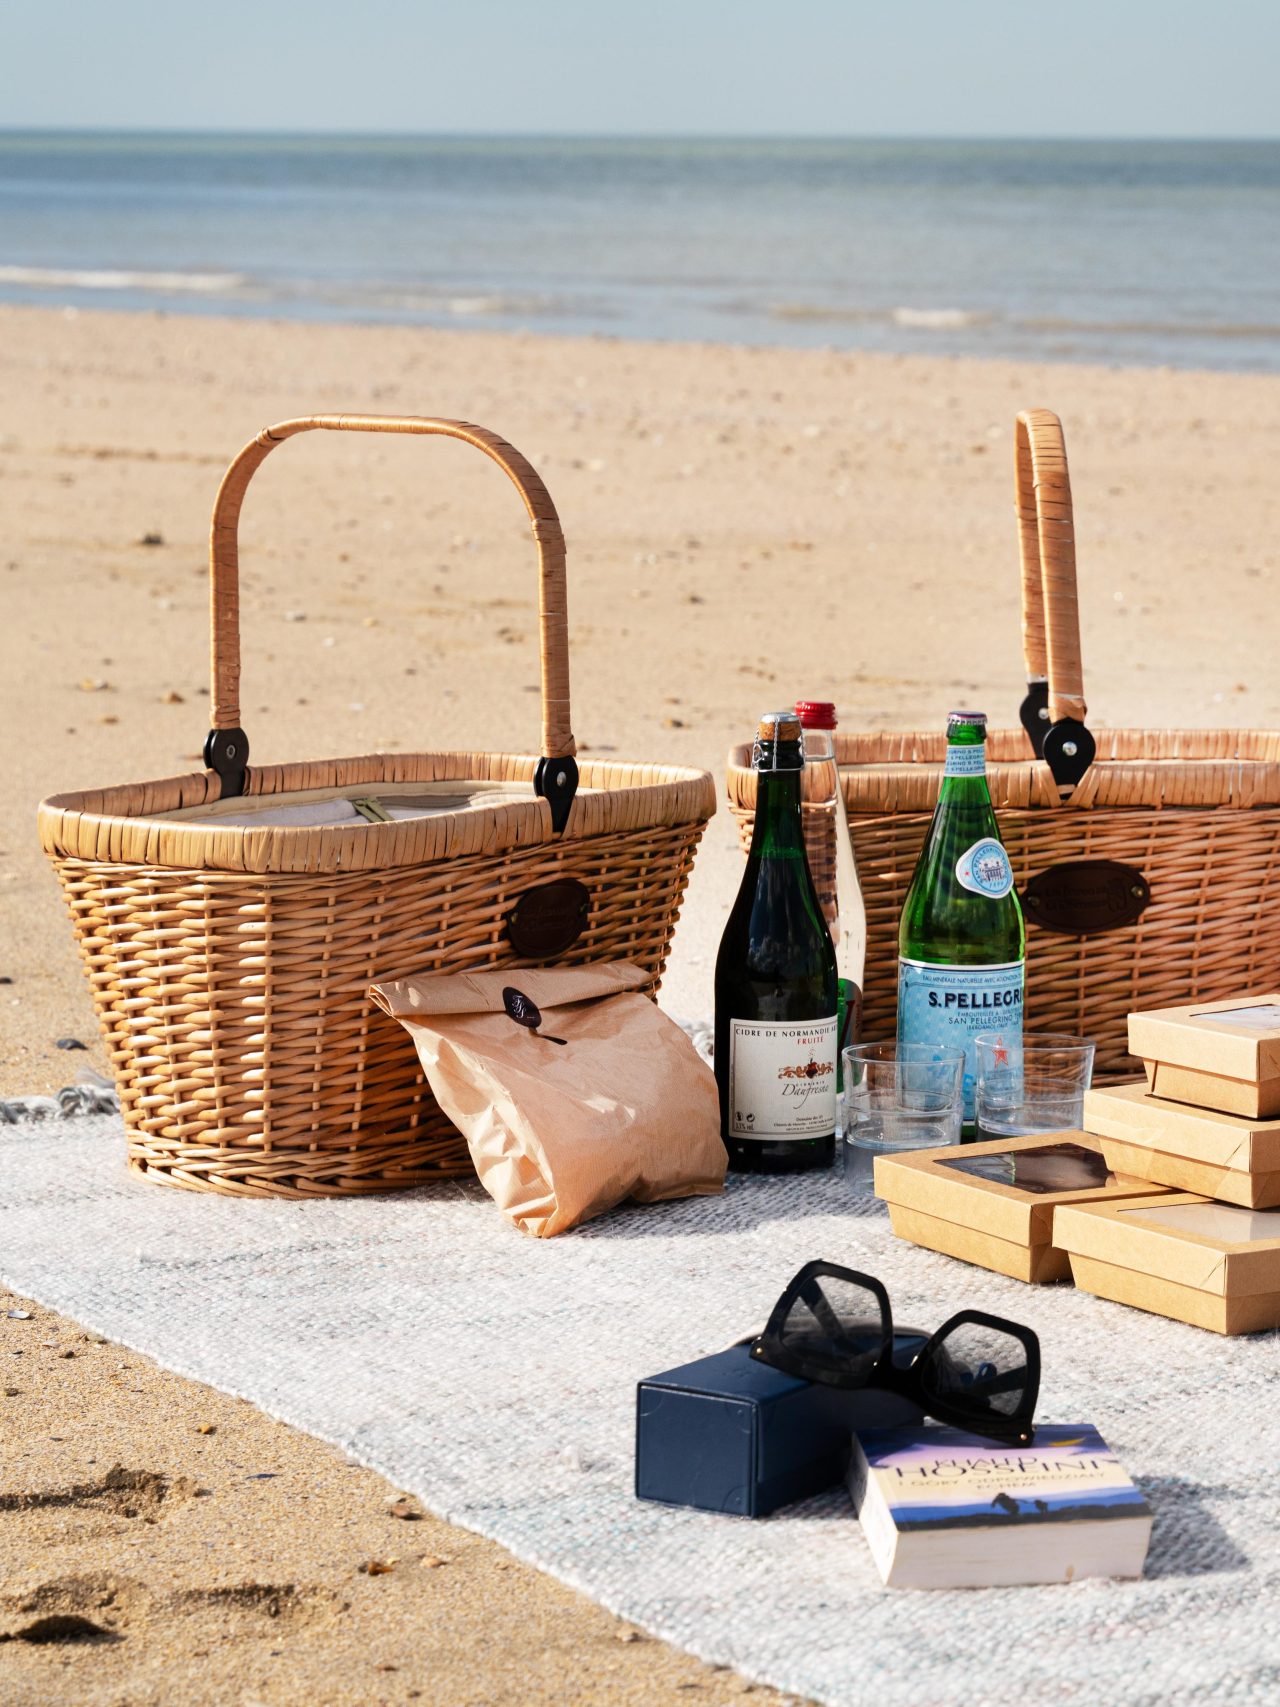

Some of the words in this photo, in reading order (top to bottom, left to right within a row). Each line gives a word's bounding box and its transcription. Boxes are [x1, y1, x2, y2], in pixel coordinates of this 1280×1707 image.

[949, 1017, 967, 1025] SAN
[970, 1014, 1013, 1025] PELLEGRINO
[735, 1028, 761, 1037] CIDRE
[781, 1026, 830, 1037] NORMANDIE
[896, 1460, 1099, 1478] HOSSEINI
